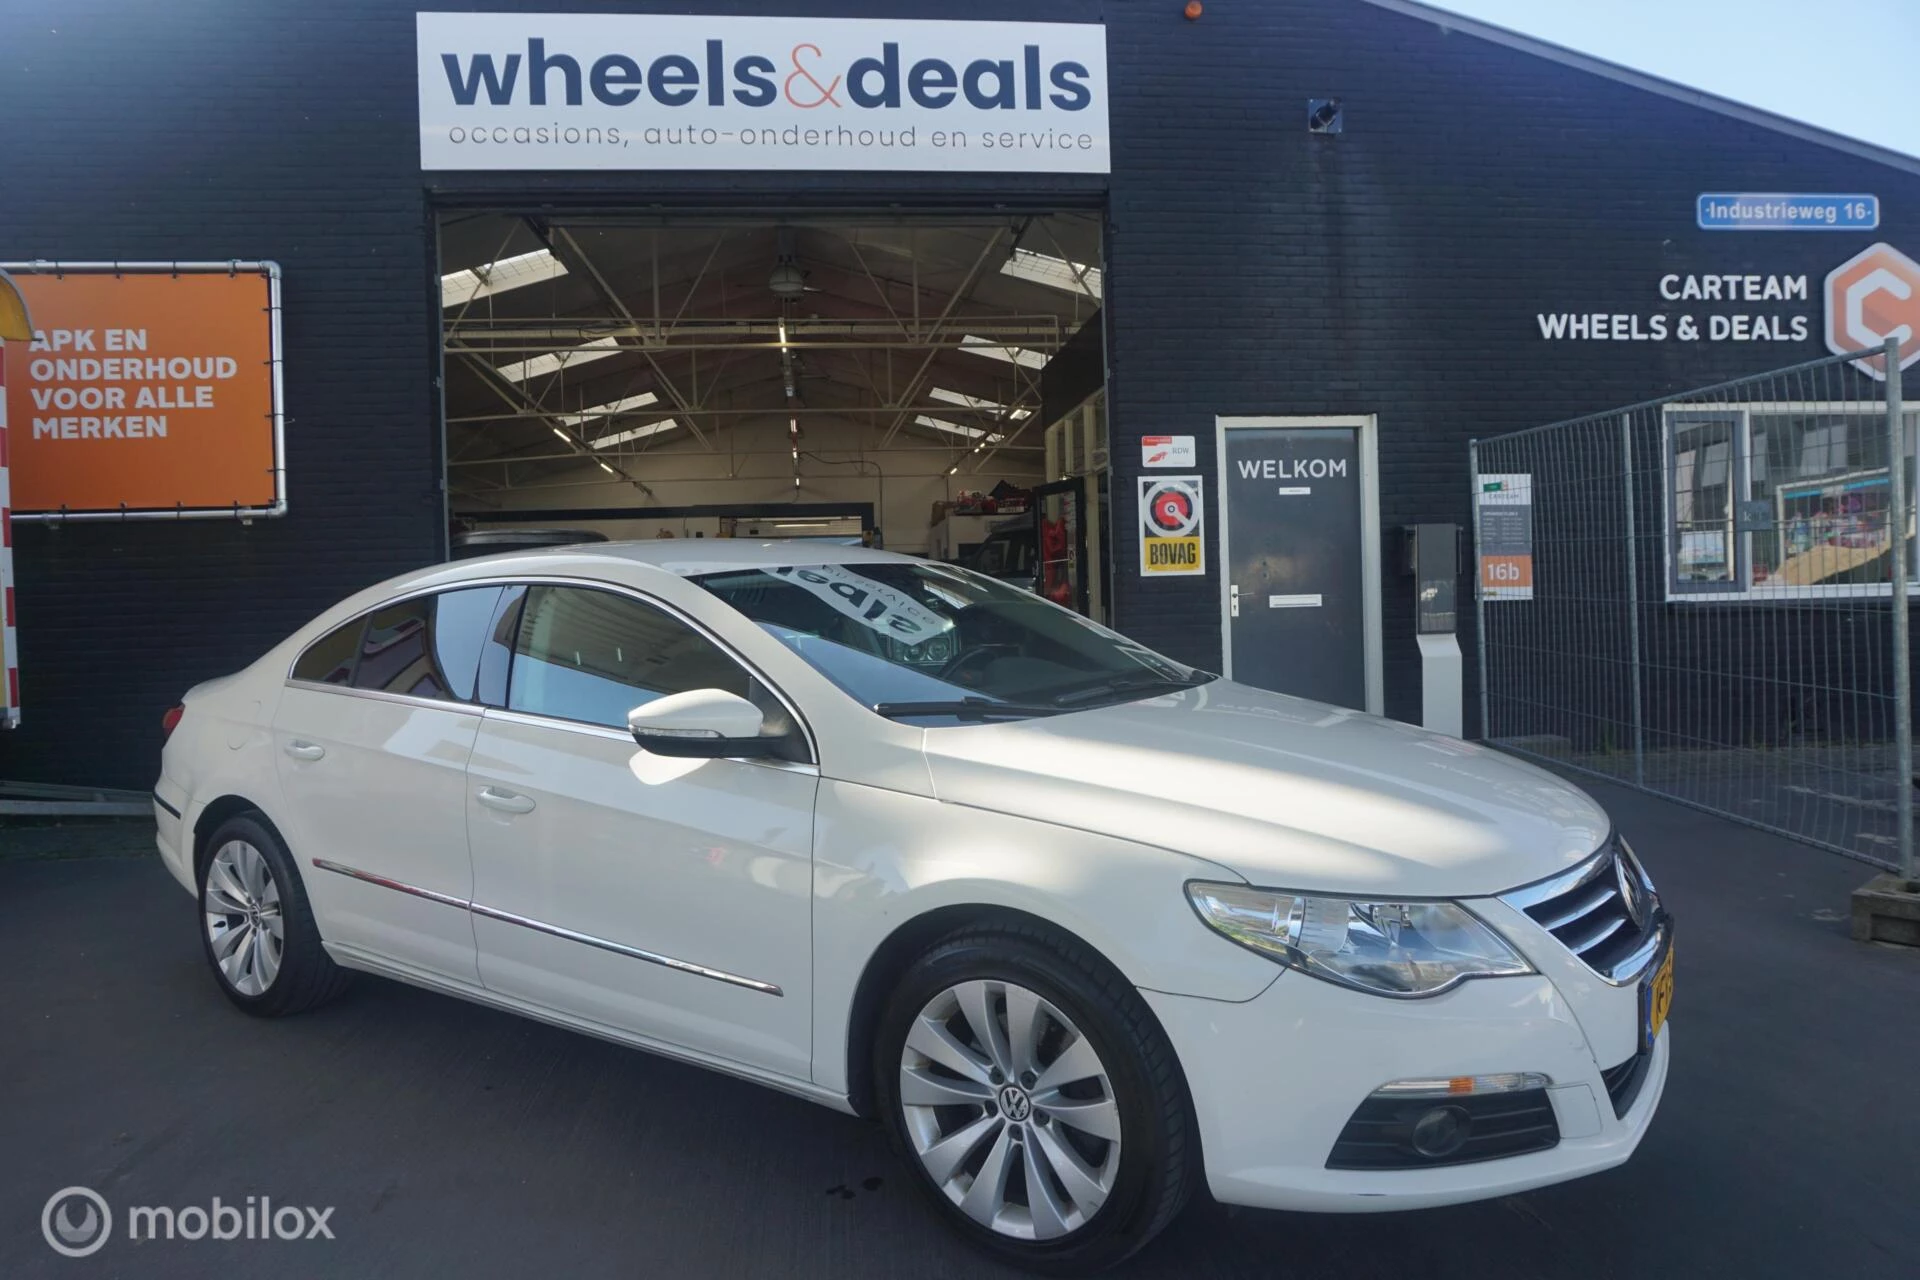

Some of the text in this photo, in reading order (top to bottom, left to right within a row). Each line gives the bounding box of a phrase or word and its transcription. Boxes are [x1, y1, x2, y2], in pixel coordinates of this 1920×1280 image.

[449, 122, 1093, 150] occasions, auto-onderhoud en service
[1710, 201, 1866, 223] Industrieweg 16
[1659, 274, 1808, 300] CARTEAM
[1537, 313, 1808, 341] WHEELS & DEALS
[29, 328, 147, 352] APK EN
[30, 356, 238, 382] ONDERHOUD
[31, 385, 214, 410] VOOR ALLE
[32, 415, 167, 440] MERKEN
[1237, 458, 1347, 479] WELKOM
[1149, 542, 1197, 566] BOVAG
[1487, 562, 1521, 581] 16b
